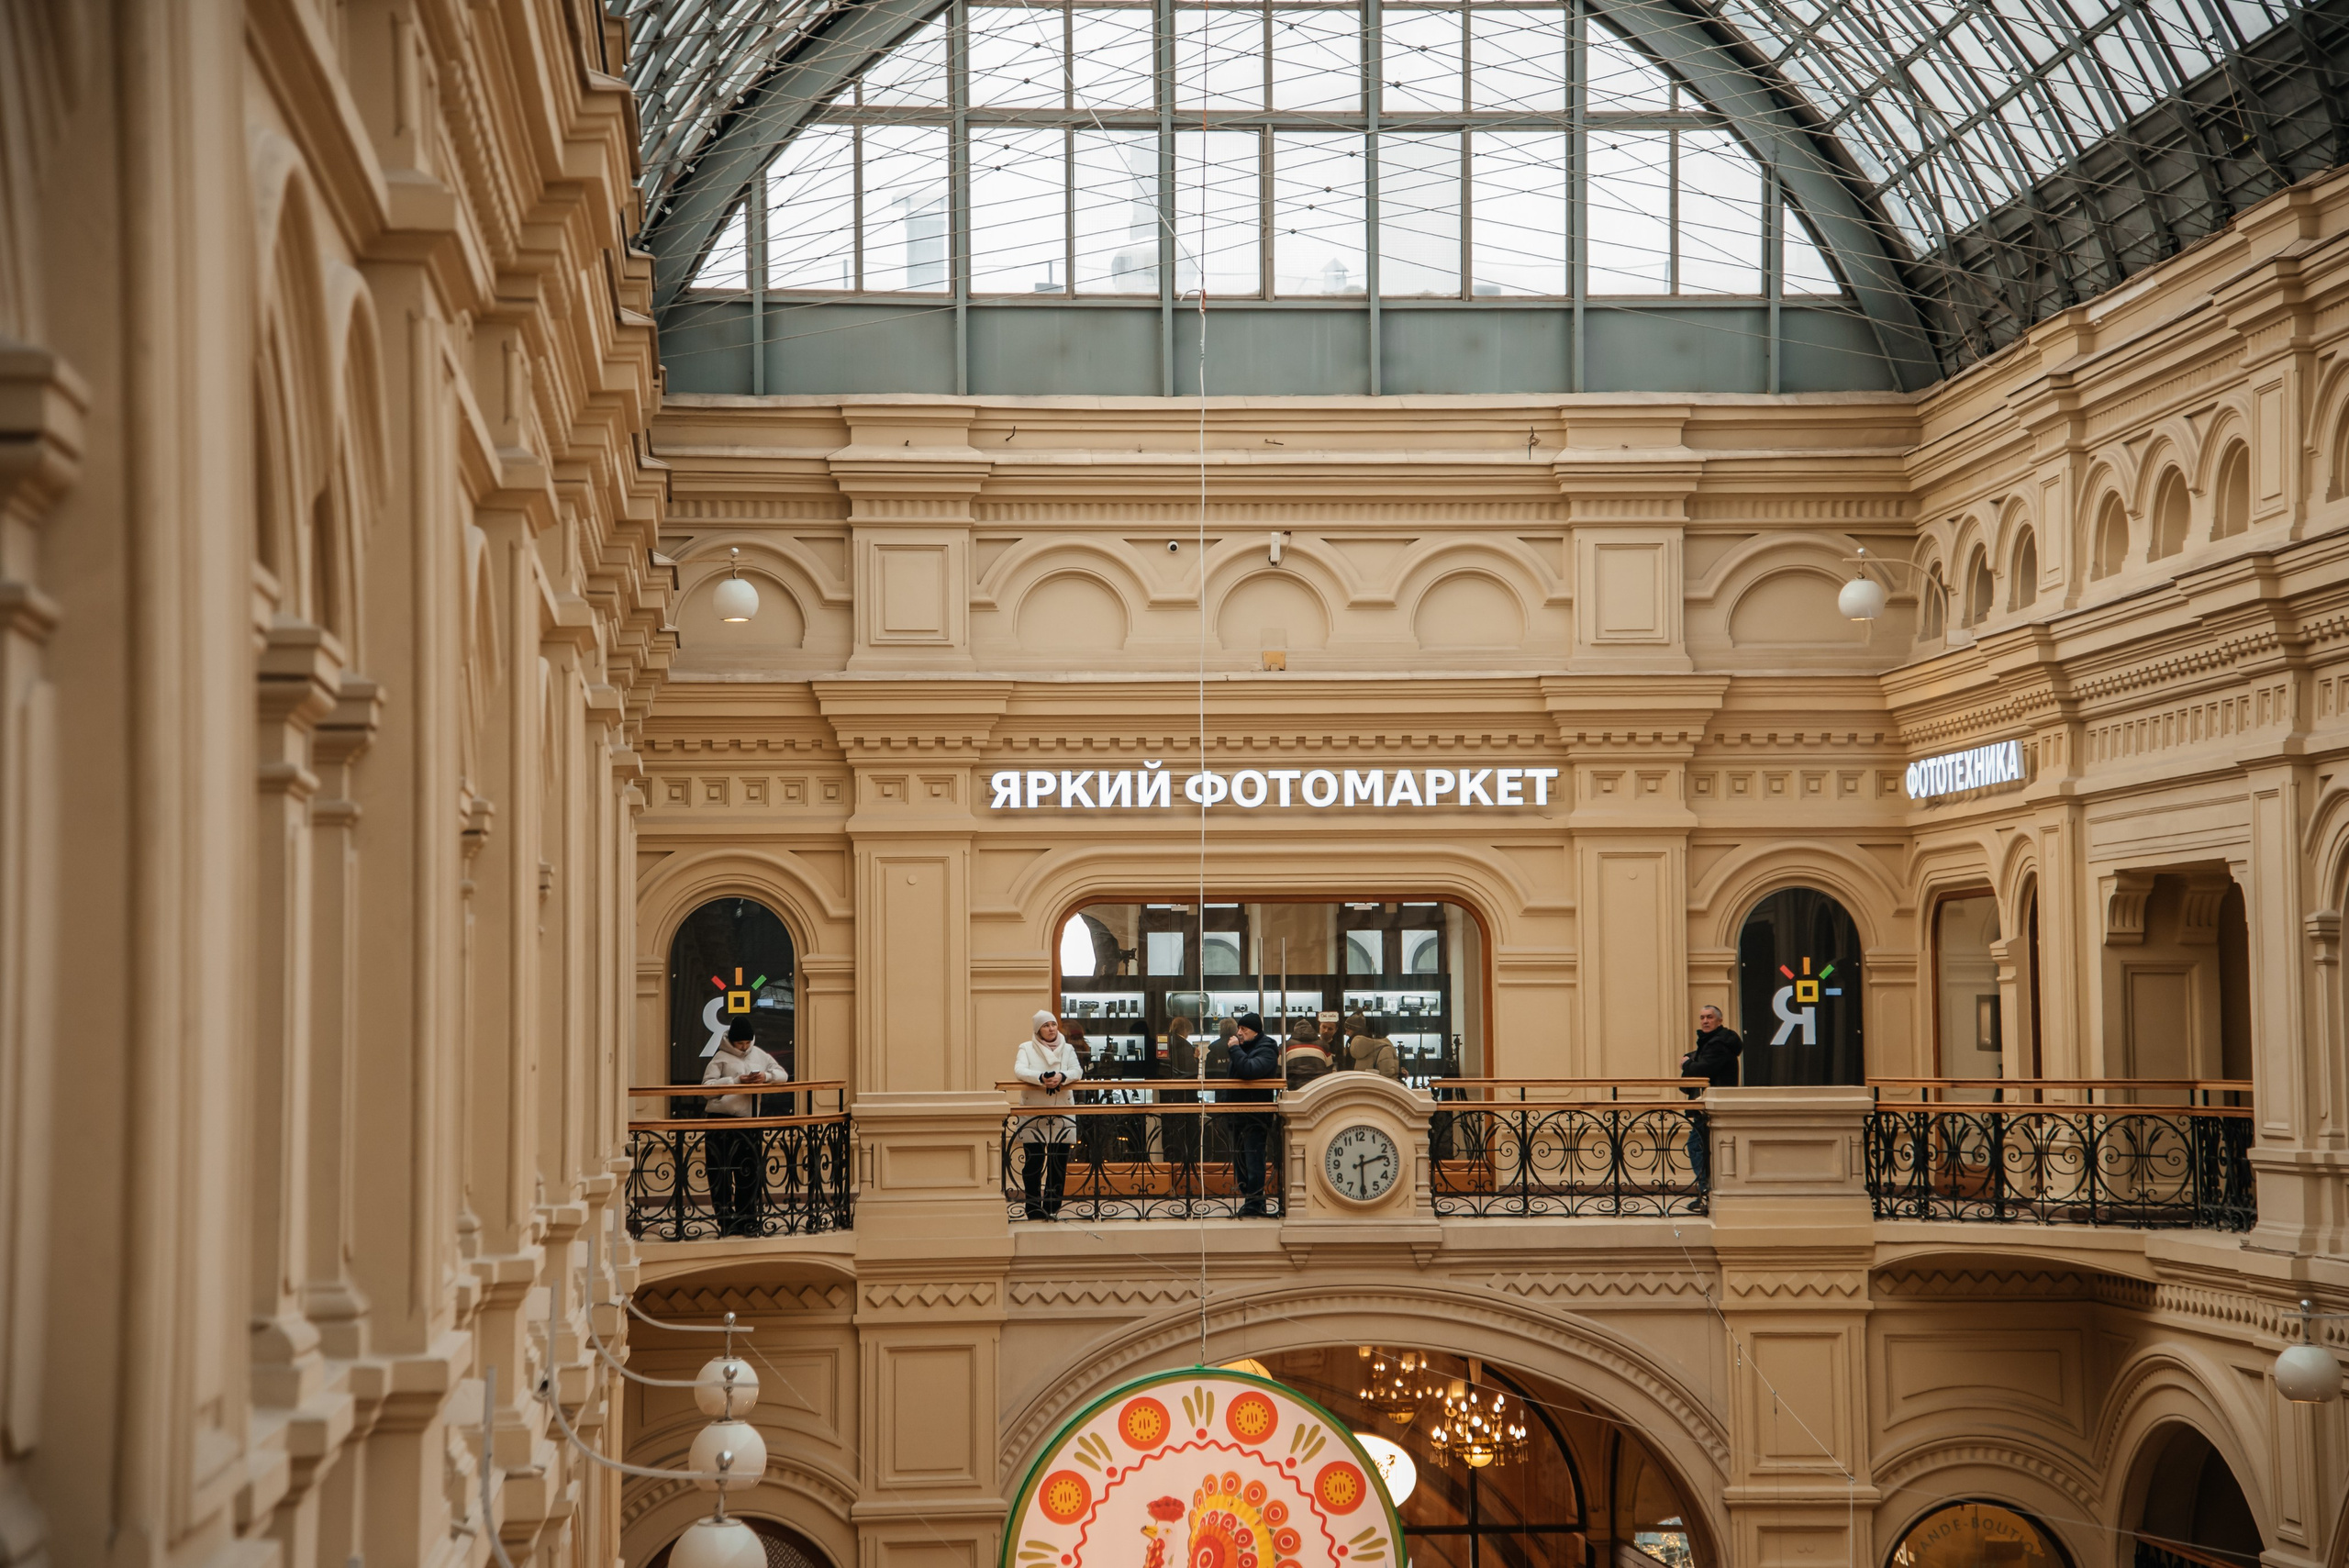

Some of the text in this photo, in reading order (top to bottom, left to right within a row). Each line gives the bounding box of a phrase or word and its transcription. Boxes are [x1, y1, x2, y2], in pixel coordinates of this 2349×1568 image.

[1906, 740, 2020, 799] ФОТОТЕХНИКА
[990, 760, 1558, 808] ЯРКИЙ ФОТОМАРКЕТ
[1344, 1136, 1352, 1146] 11
[1355, 1131, 1365, 1141] 12
[1334, 1147, 1343, 1156] 10
[1381, 1143, 1387, 1153] 2
[1333, 1160, 1341, 1170] 9
[1383, 1156, 1390, 1167] 3
[1337, 1173, 1343, 1184] 8
[1380, 1170, 1388, 1180] 4
[1347, 1182, 1353, 1192] 7
[1373, 1181, 1379, 1191] 5
